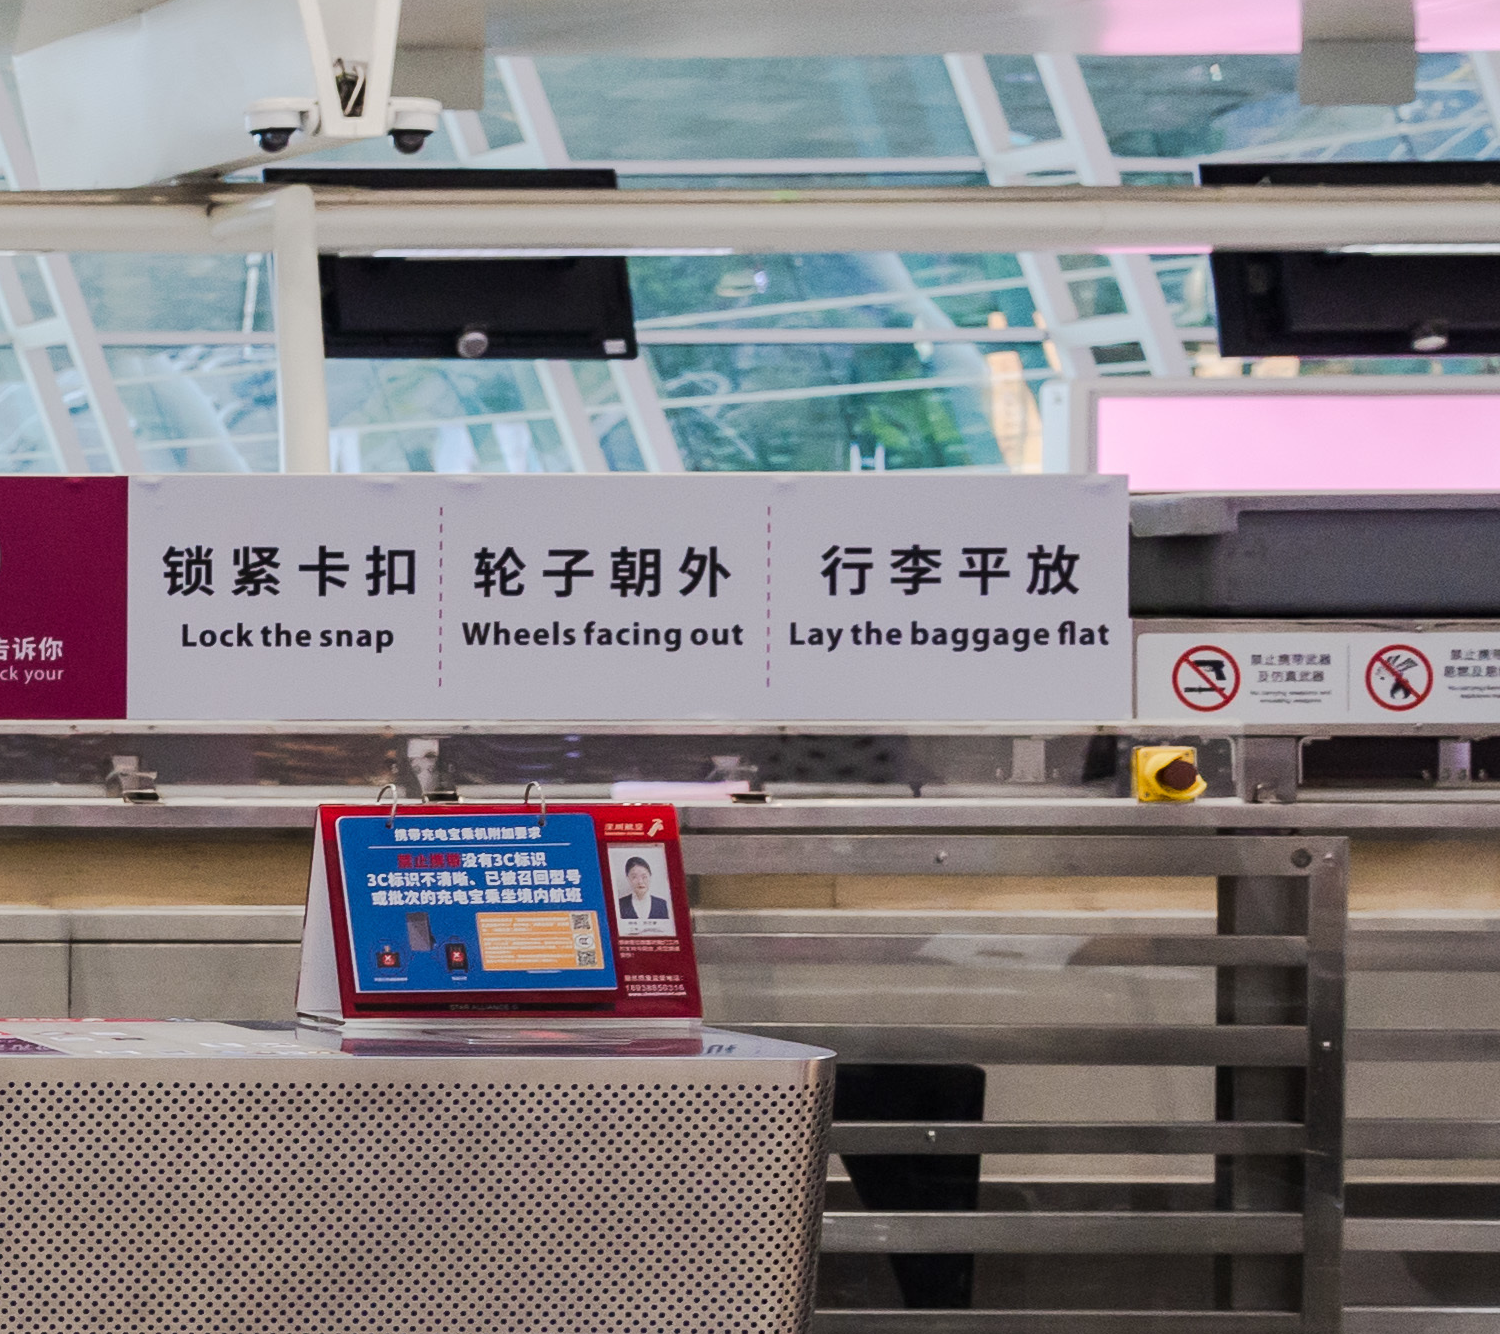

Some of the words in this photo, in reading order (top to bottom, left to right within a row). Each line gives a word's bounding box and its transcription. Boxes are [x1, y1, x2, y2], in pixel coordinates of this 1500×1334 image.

[163, 546, 415, 596] 锁紧卡扣
[474, 547, 730, 597] 轮子朝外
[821, 545, 1079, 595] 行李平放
[183, 623, 253, 647] Lock
[261, 623, 311, 647] the
[320, 630, 393, 653] snap
[462, 622, 575, 645] Wheels
[584, 621, 681, 651] facing
[691, 625, 743, 645] out
[791, 623, 843, 652] Lay
[851, 621, 902, 645] the
[912, 621, 1049, 652] baggage
[1058, 621, 1109, 645] flat
[24, 670, 64, 684] your
